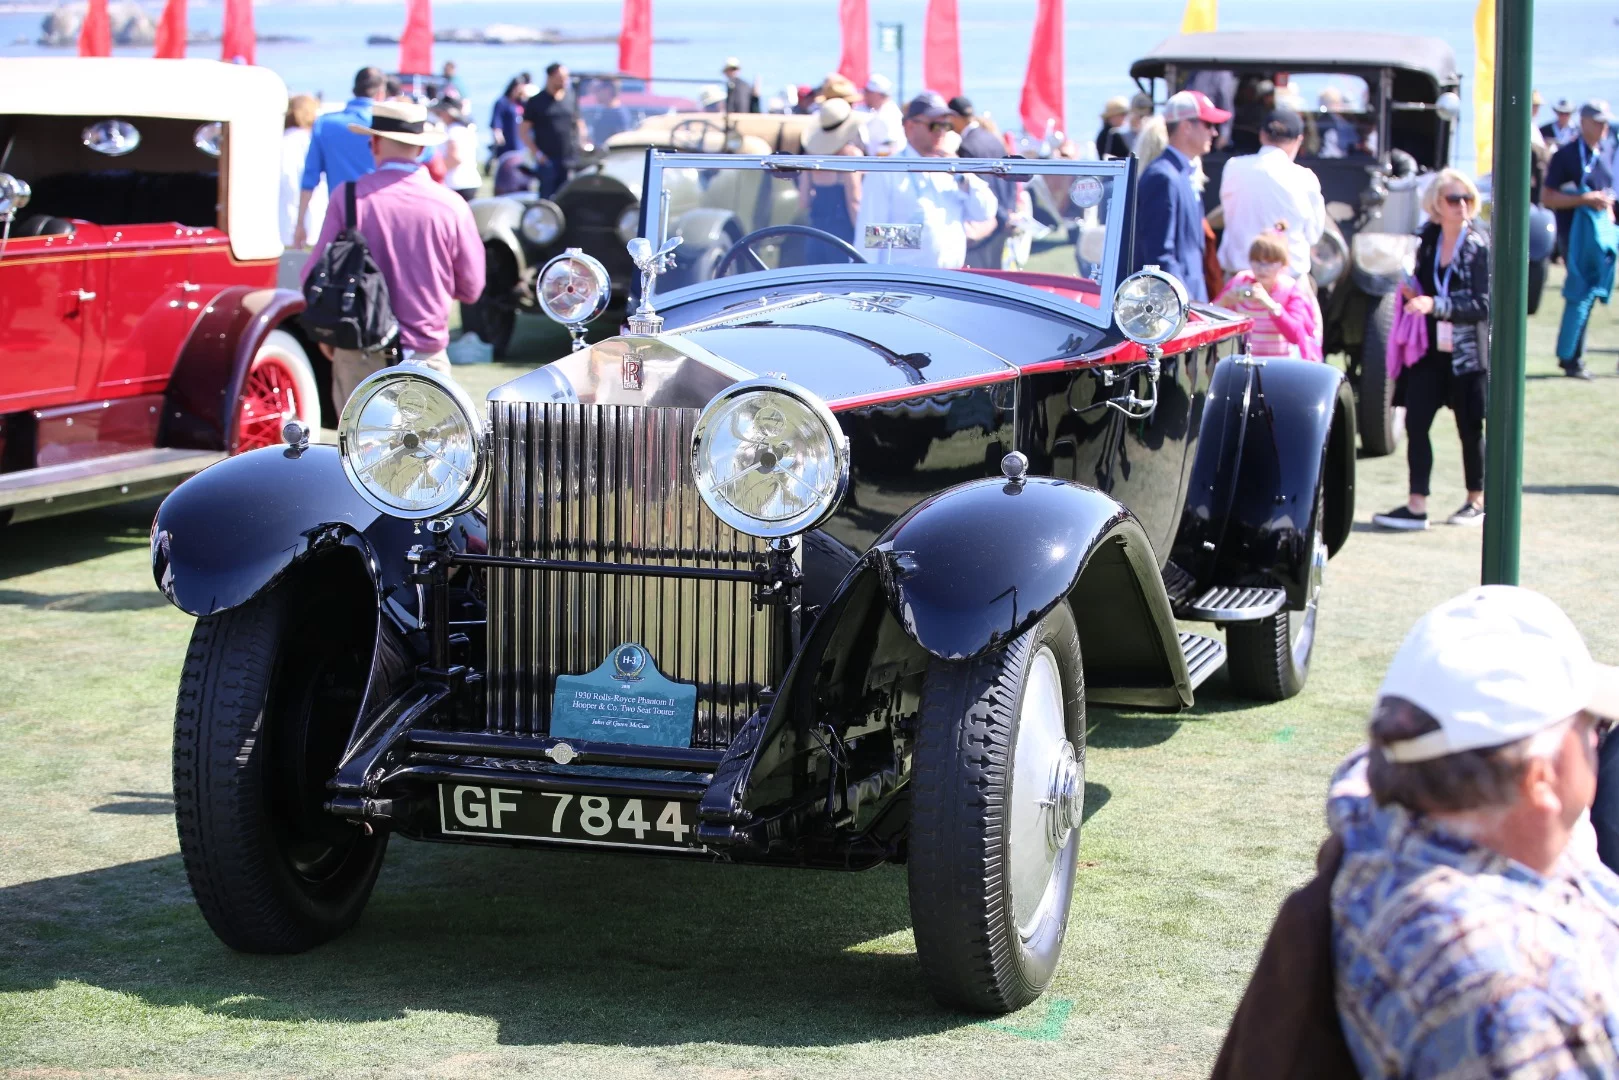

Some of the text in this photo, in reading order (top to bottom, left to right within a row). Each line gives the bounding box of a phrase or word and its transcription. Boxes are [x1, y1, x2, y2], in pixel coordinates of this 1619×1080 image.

[622, 655, 637, 664] H-3
[574, 691, 675, 707] 1930 Rolls-Royce Phantom II
[572, 700, 676, 716] Hooper & Co. Two Seat Tourer
[453, 785, 690, 842] GF 7844
